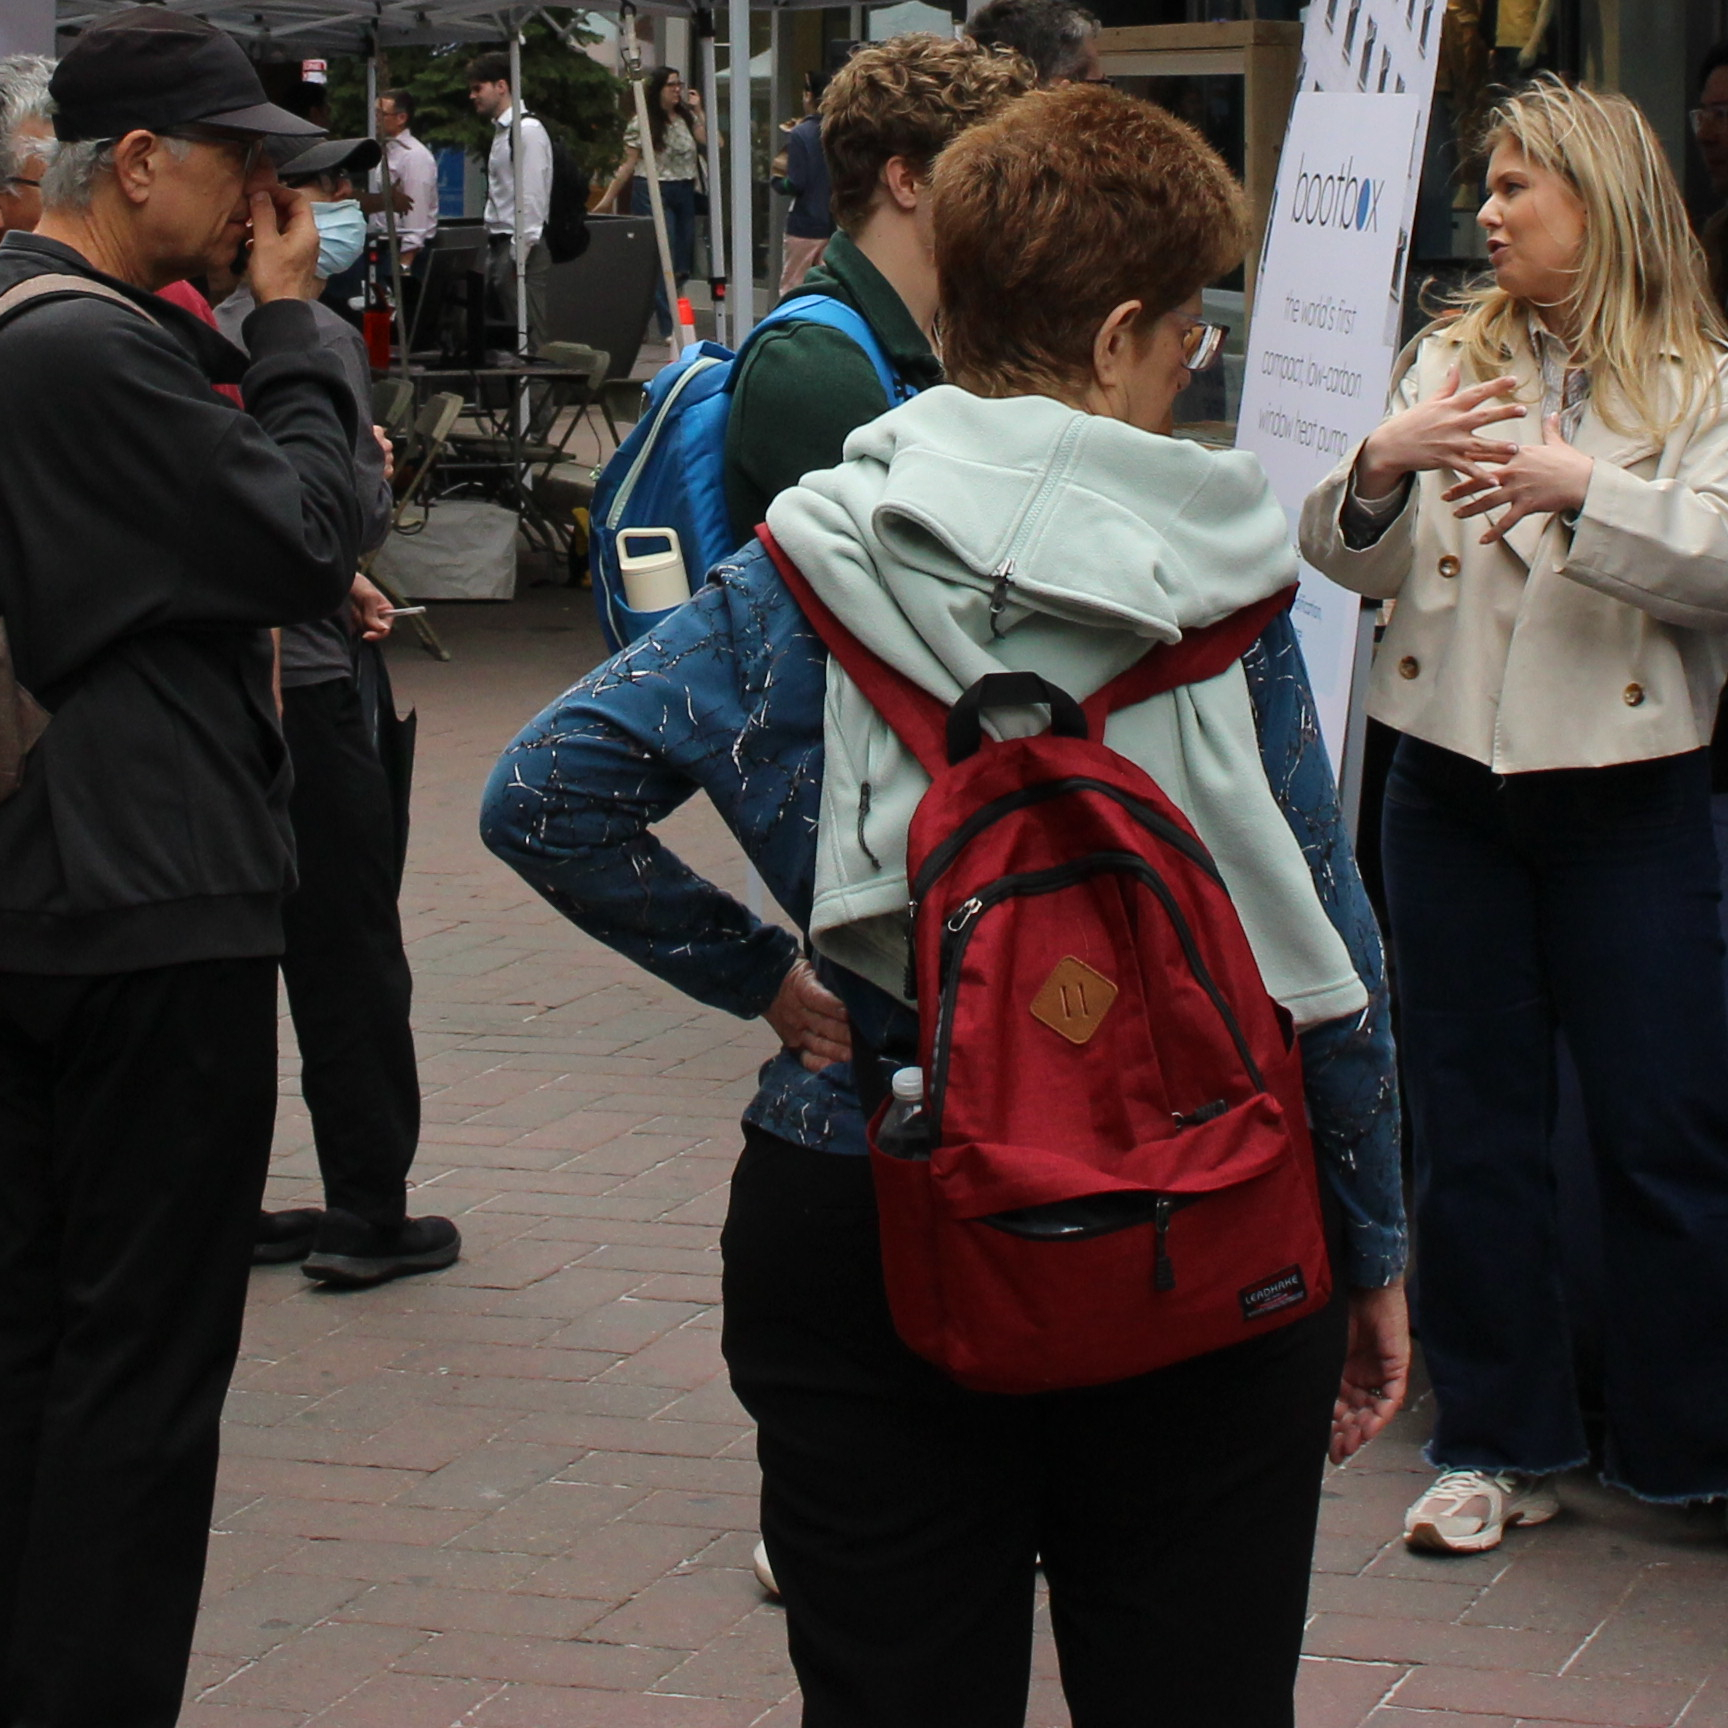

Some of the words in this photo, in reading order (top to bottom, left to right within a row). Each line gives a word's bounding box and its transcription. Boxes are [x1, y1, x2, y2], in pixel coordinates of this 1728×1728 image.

[1284, 291, 1300, 323] the
[1301, 291, 1336, 334] world's
[1337, 299, 1357, 335] first
[1261, 350, 1304, 389] compact,
[1308, 352, 1362, 400] low-carbon
[1258, 403, 1293, 440] window
[1293, 409, 1317, 450] heat
[1317, 425, 1347, 460] pump
